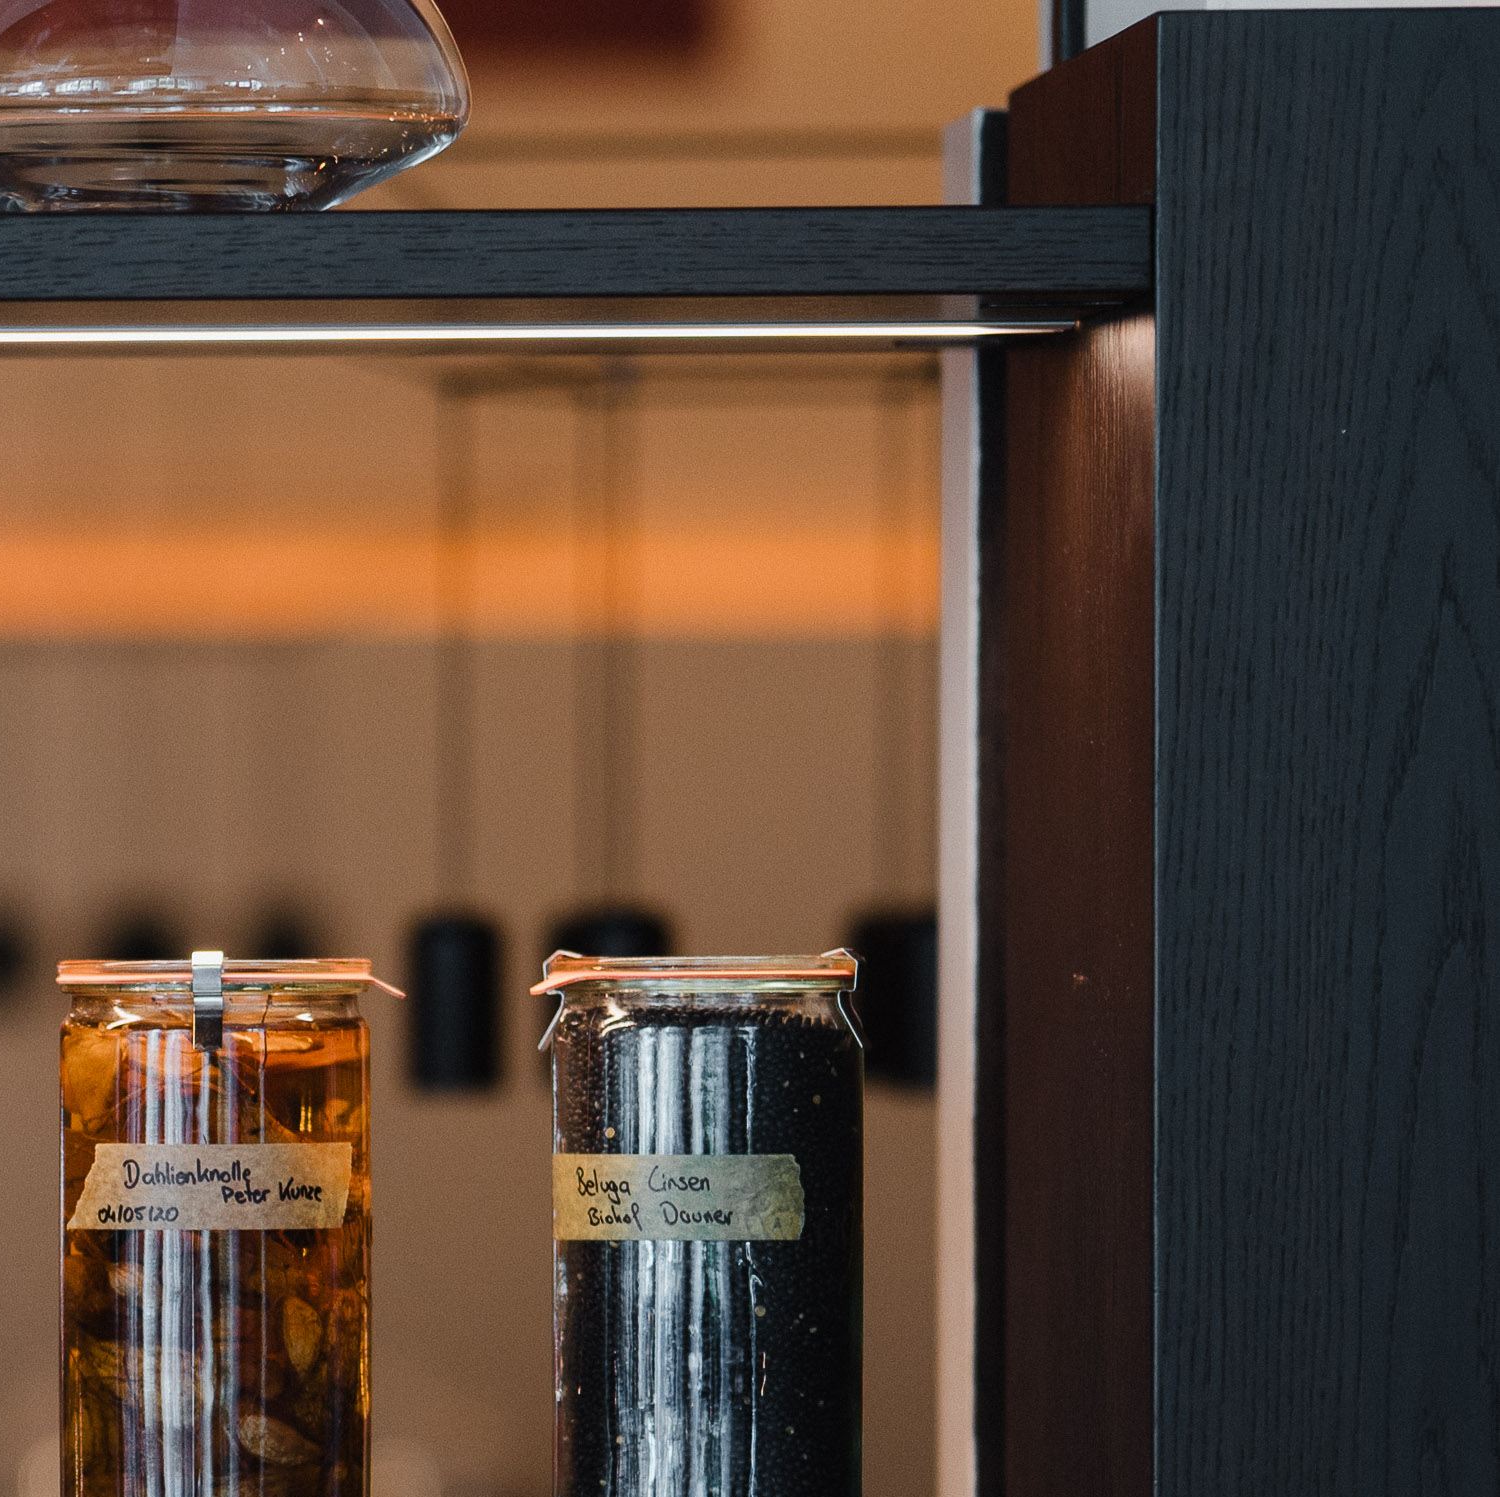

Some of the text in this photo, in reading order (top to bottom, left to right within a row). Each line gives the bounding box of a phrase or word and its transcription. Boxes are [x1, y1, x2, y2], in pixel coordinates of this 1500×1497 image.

[122, 1158, 251, 1189] Dahlienknolle
[576, 1166, 631, 1205] Beluga
[221, 1177, 323, 1204] Peter Kunze
[587, 1202, 643, 1232] Biohof
